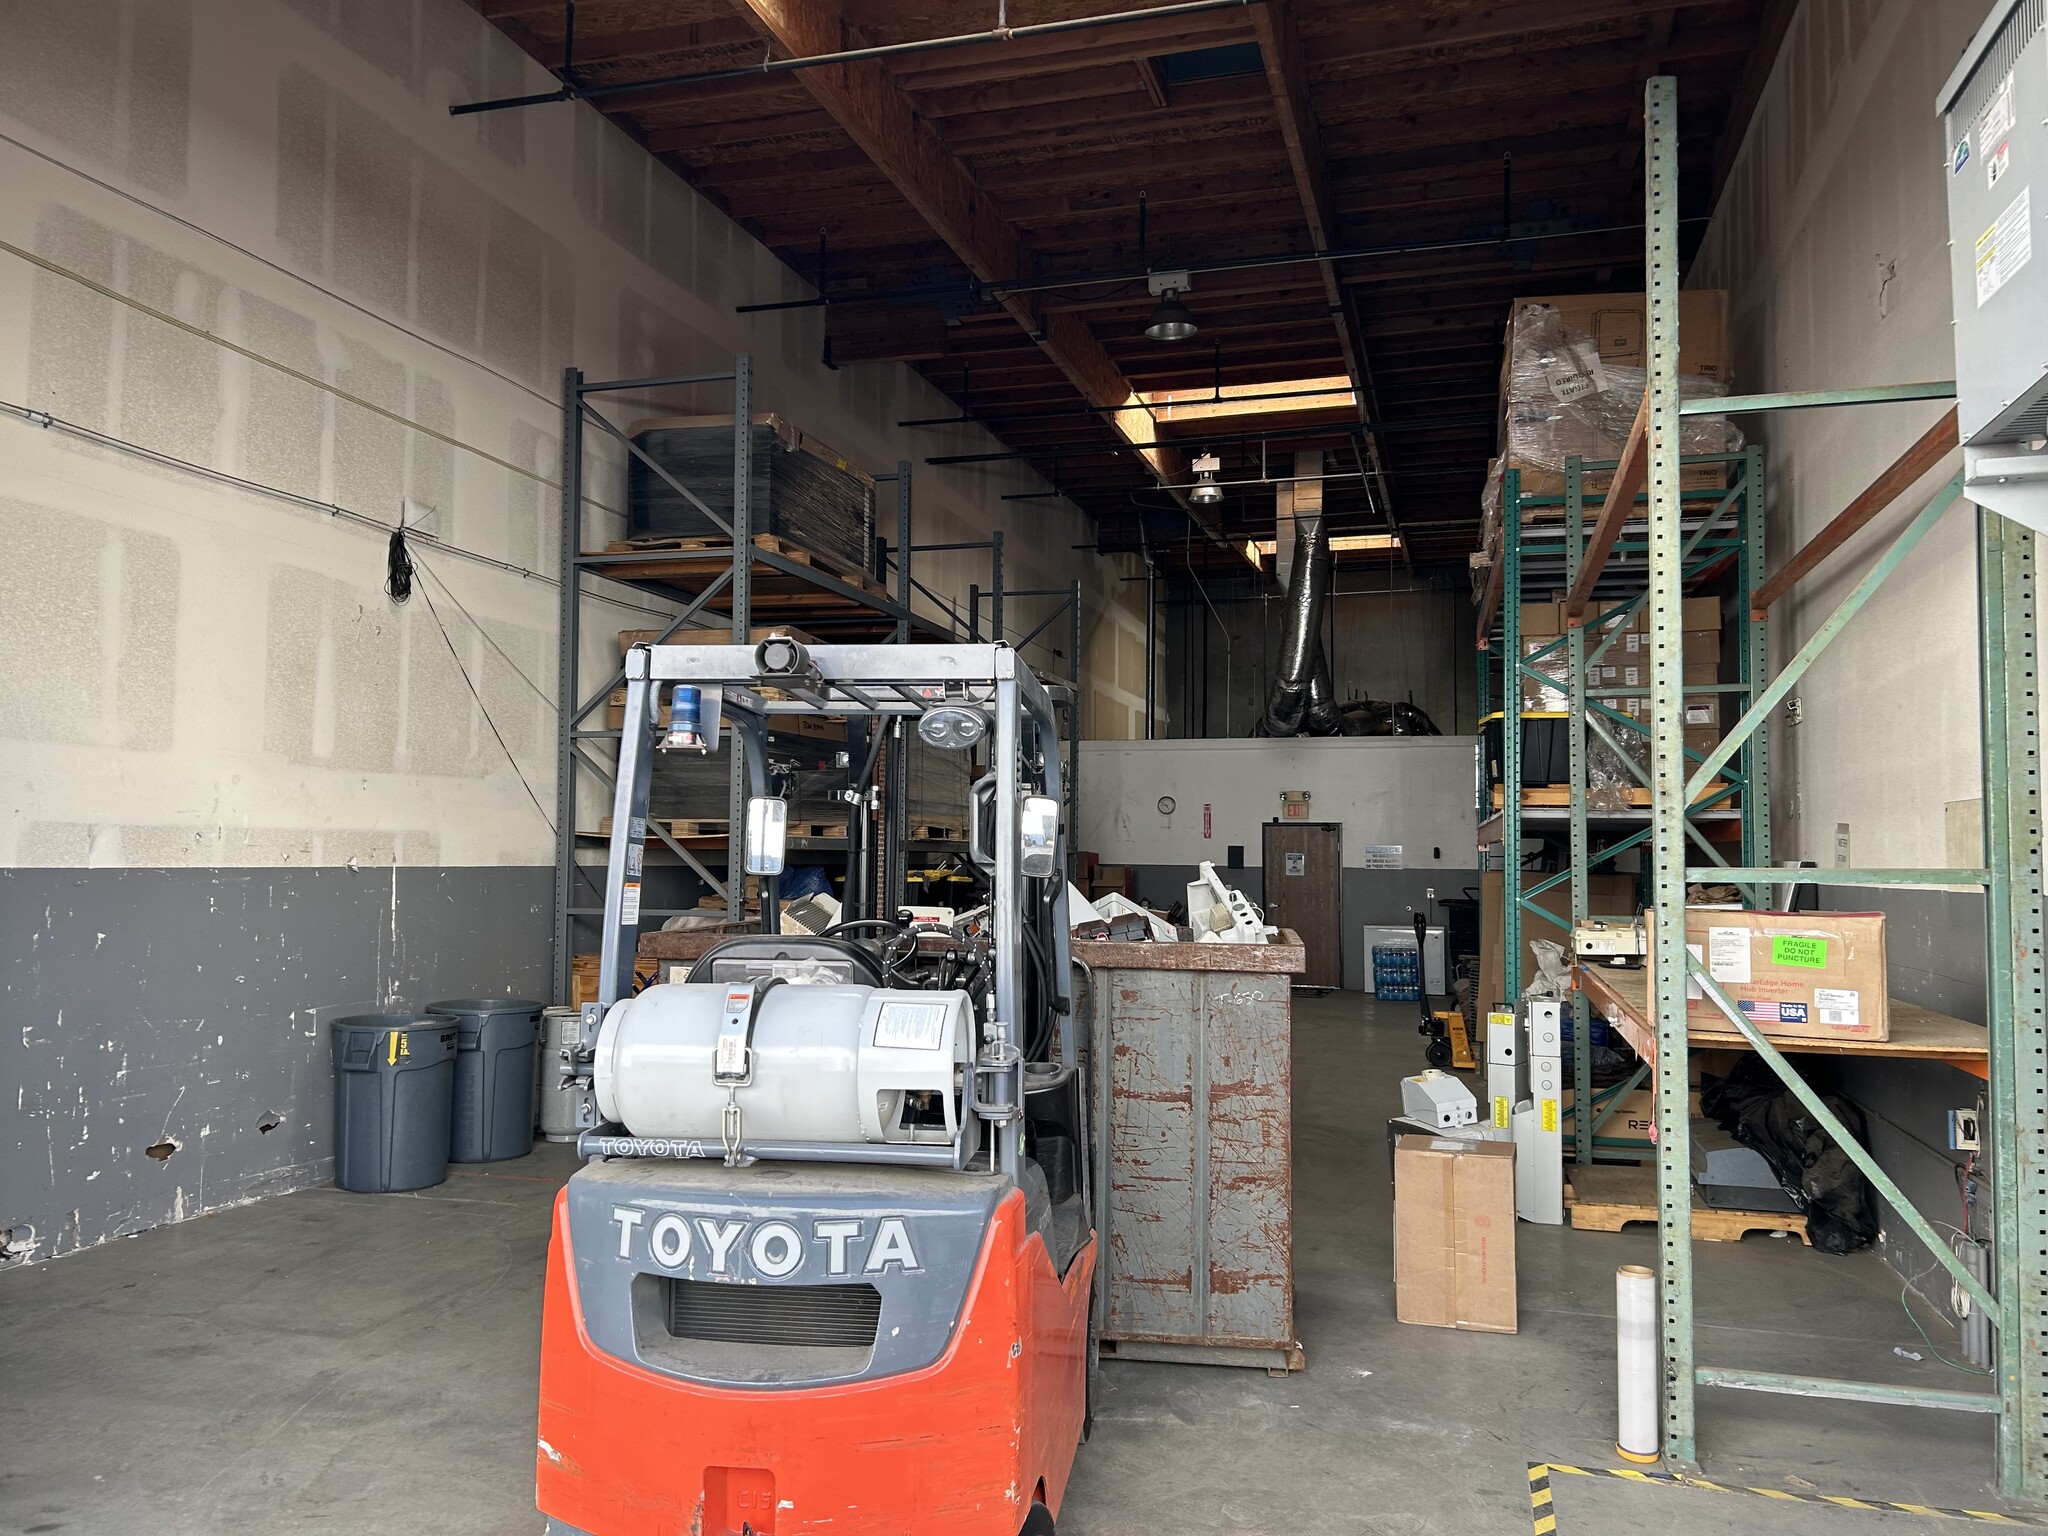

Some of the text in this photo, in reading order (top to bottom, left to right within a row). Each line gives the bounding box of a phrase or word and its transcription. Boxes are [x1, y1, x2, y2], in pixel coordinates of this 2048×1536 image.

[1699, 364, 1717, 372] TRIO
[1287, 803, 1305, 817] EXIT
[1782, 940, 1817, 949] FRAGILE
[1777, 953, 1821, 964] PUNCTURE
[1781, 980, 1805, 988] Home
[1759, 986, 1789, 995] Inverter
[1781, 1008, 1806, 1017] USA
[400, 1038, 408, 1049] 5
[599, 1137, 706, 1158] TOYOTA
[611, 1204, 924, 1280] TOYOTA
